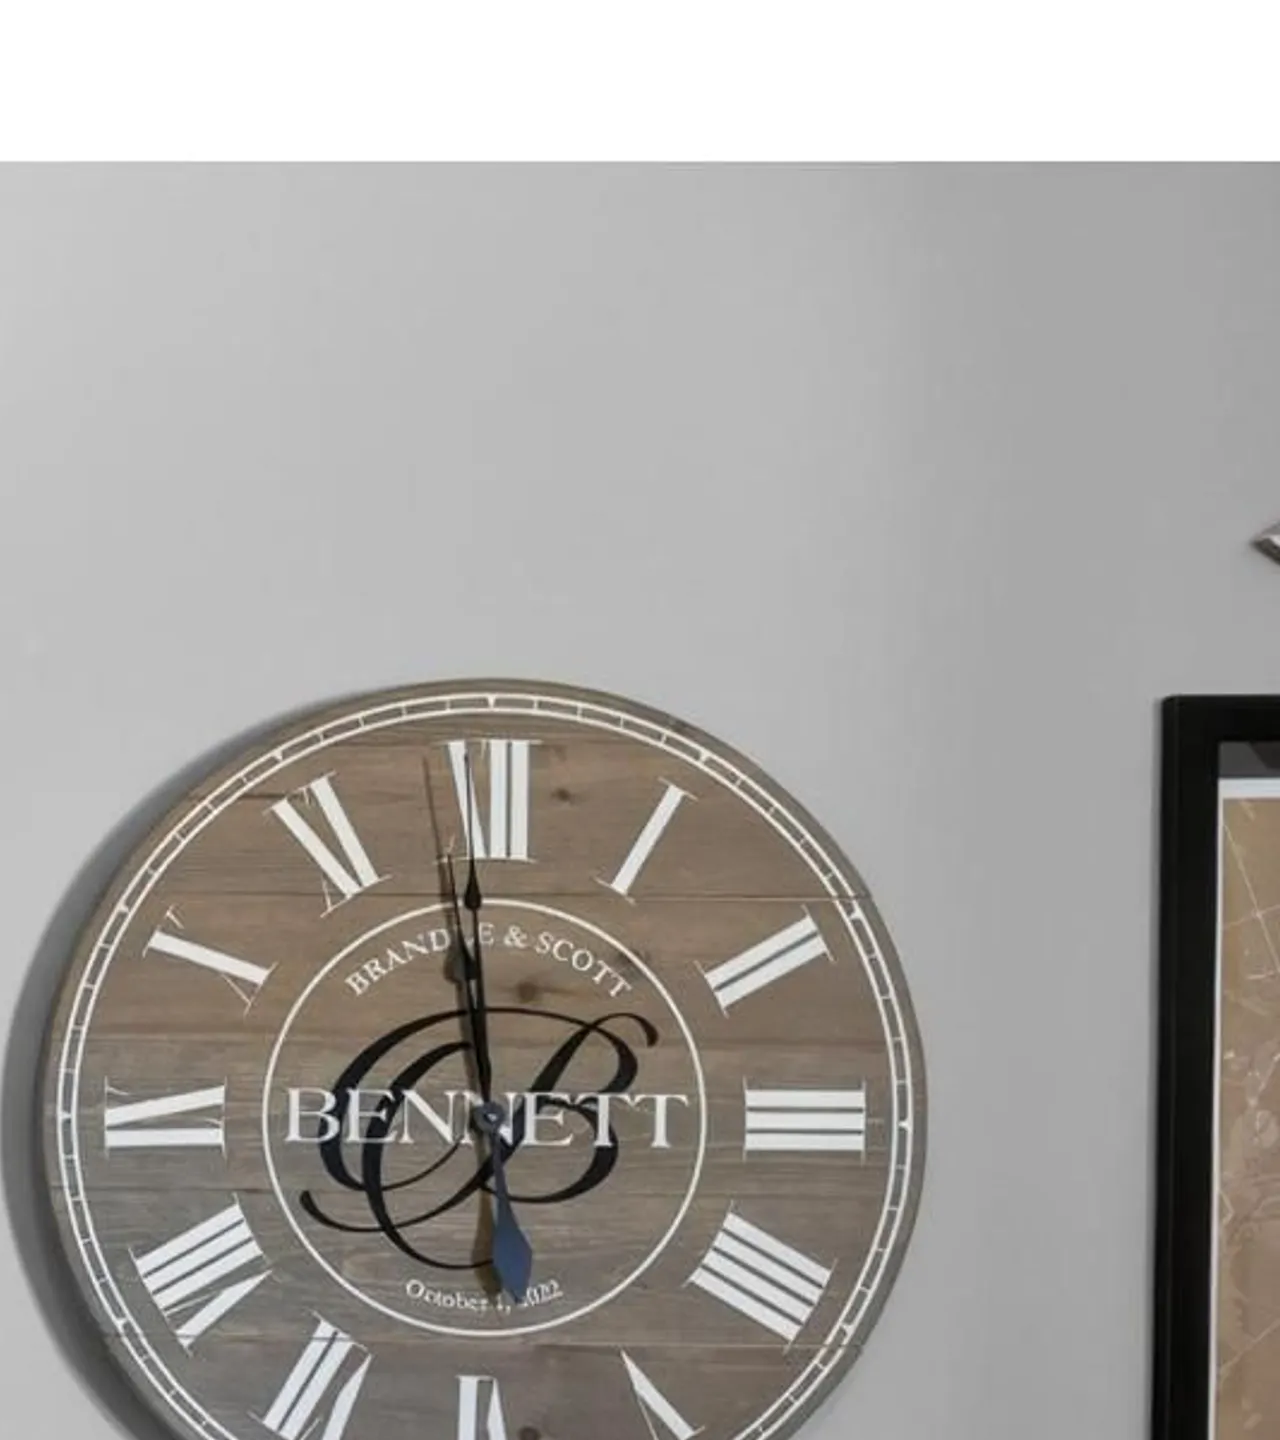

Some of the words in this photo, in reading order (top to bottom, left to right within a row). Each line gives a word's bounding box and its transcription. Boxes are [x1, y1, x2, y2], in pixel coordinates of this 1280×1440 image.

[593, 776, 698, 905] I
[344, 921, 497, 996] BRANDE
[503, 925, 528, 948] &
[534, 930, 632, 998] SCOTT
[693, 904, 837, 1018] II
[285, 1086, 688, 1149] BENNETT
[742, 1075, 868, 1166] III
